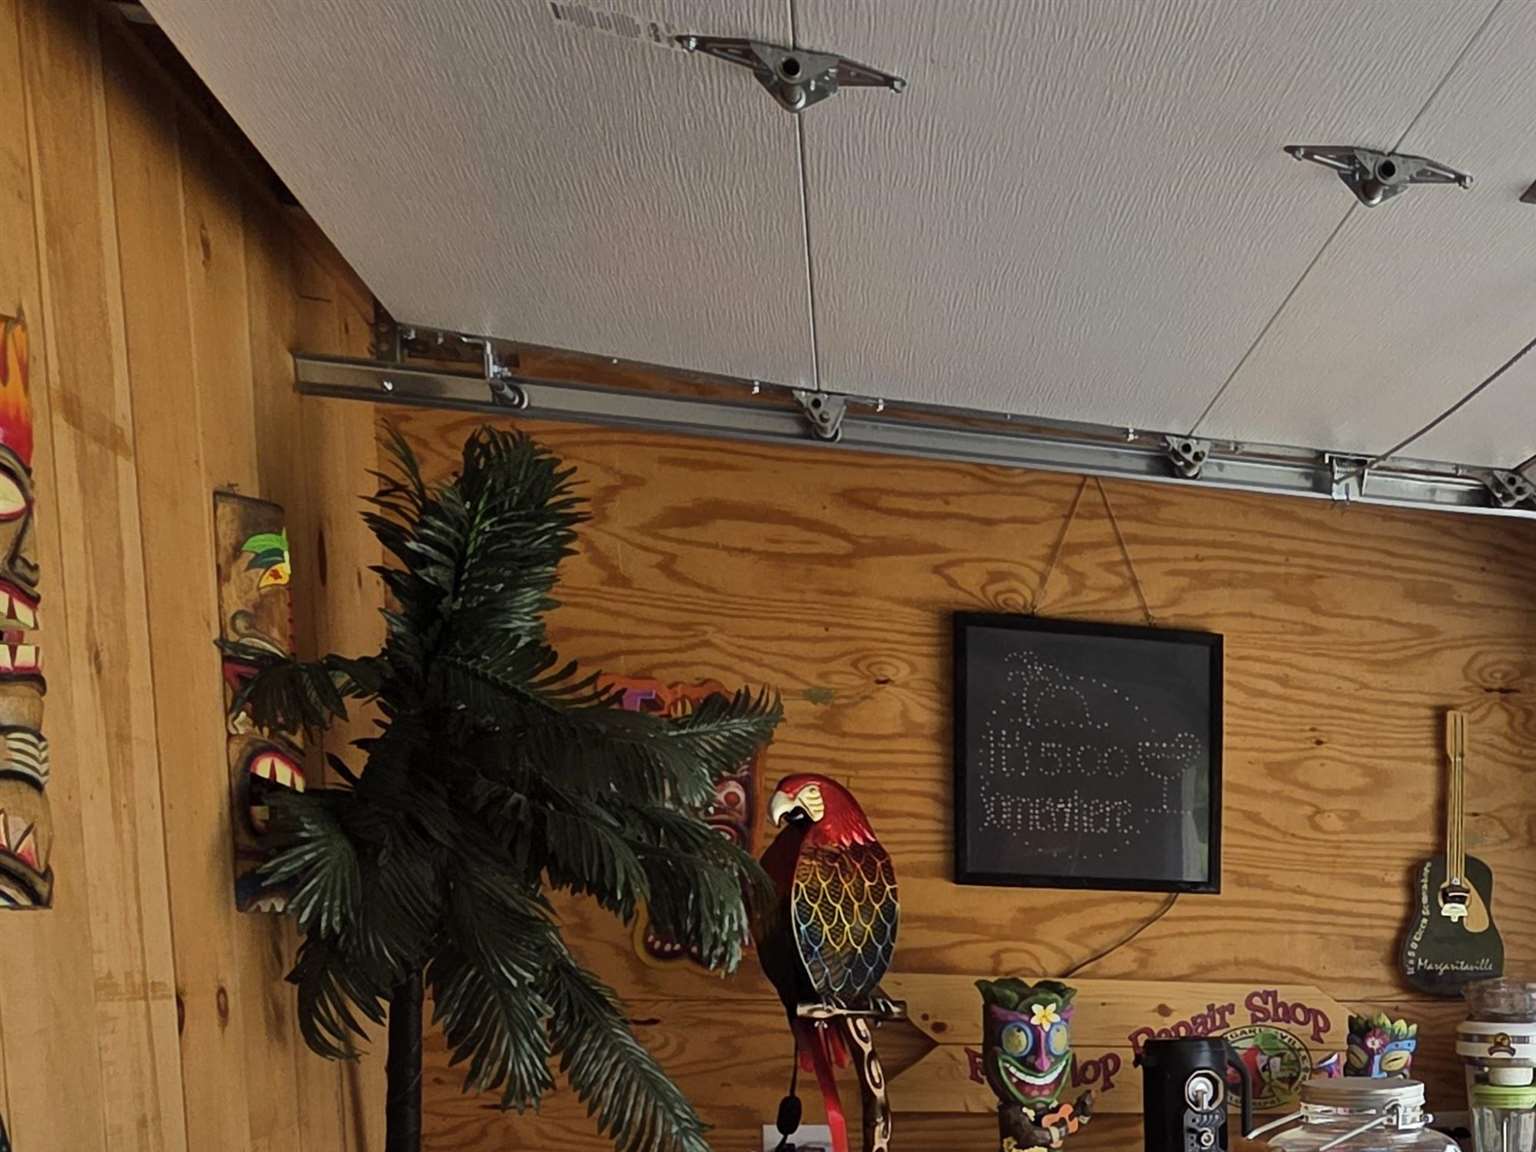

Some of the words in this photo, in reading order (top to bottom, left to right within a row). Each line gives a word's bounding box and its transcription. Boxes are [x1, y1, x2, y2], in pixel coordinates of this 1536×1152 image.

[1039, 742, 1129, 778] 5:00
[1417, 957, 1493, 976] Margaritaville
[1244, 989, 1331, 1045] Shop
